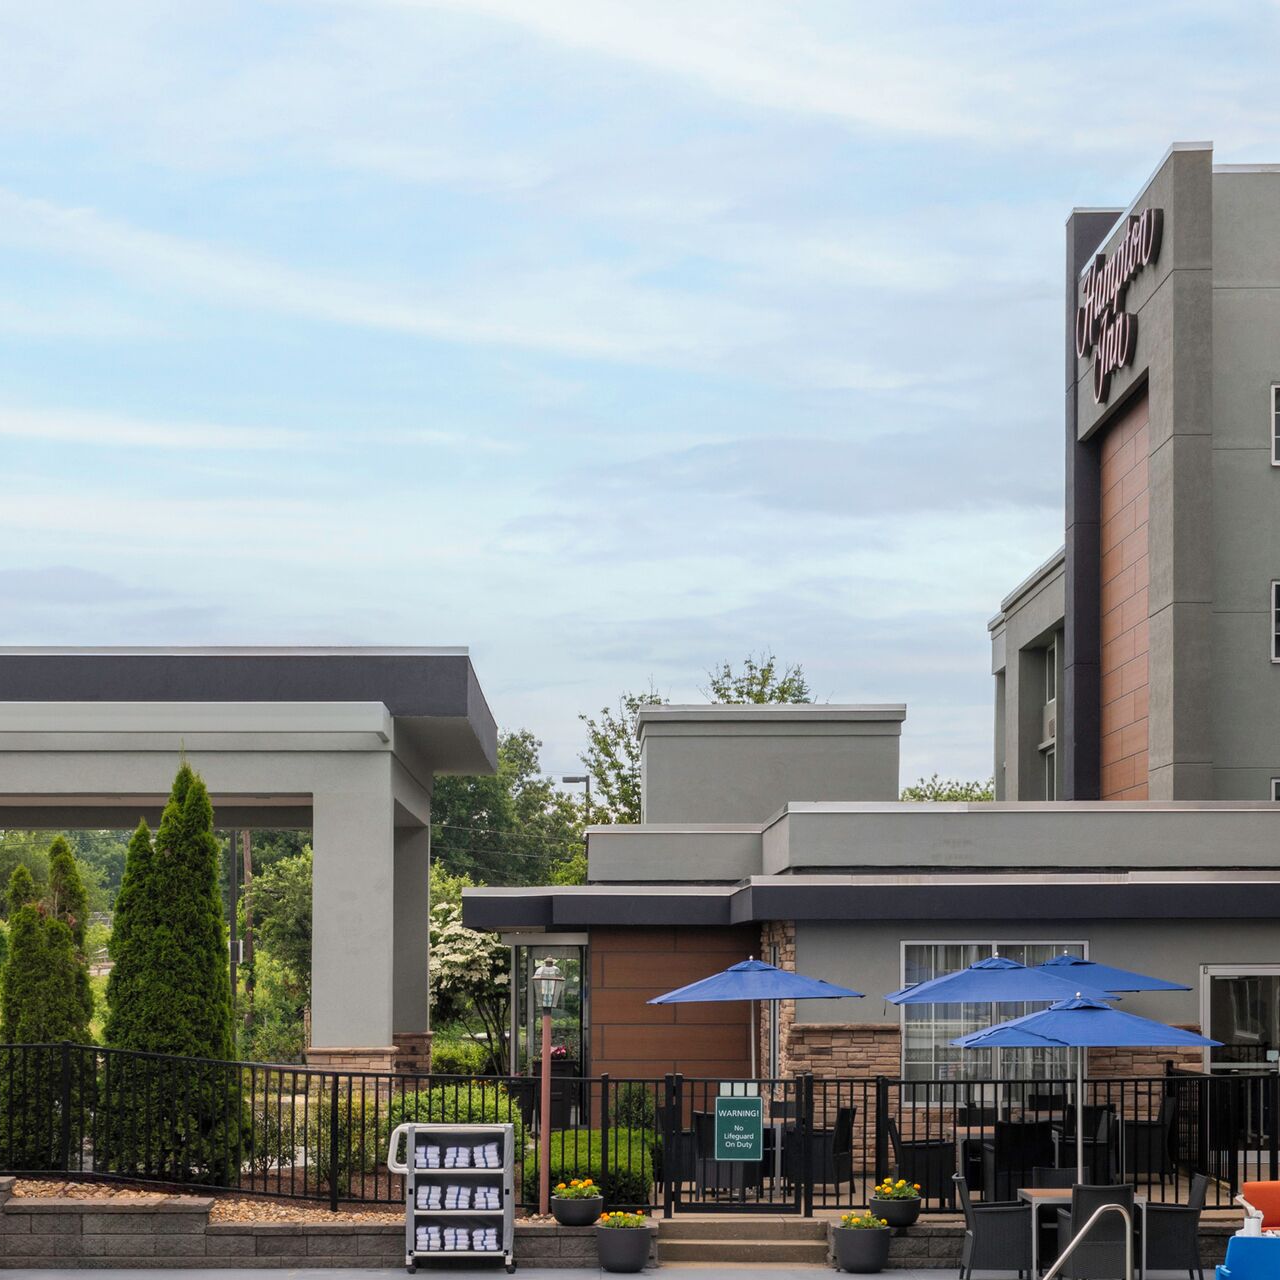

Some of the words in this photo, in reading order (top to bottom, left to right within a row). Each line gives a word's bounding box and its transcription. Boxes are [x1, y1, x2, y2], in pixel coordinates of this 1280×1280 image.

[1076, 208, 1164, 359] Hampton
[1094, 309, 1138, 404] Inn
[718, 1110, 760, 1118] WARNING!
[724, 1133, 754, 1141] Lifeguard
[737, 1141, 753, 1149] Duty
